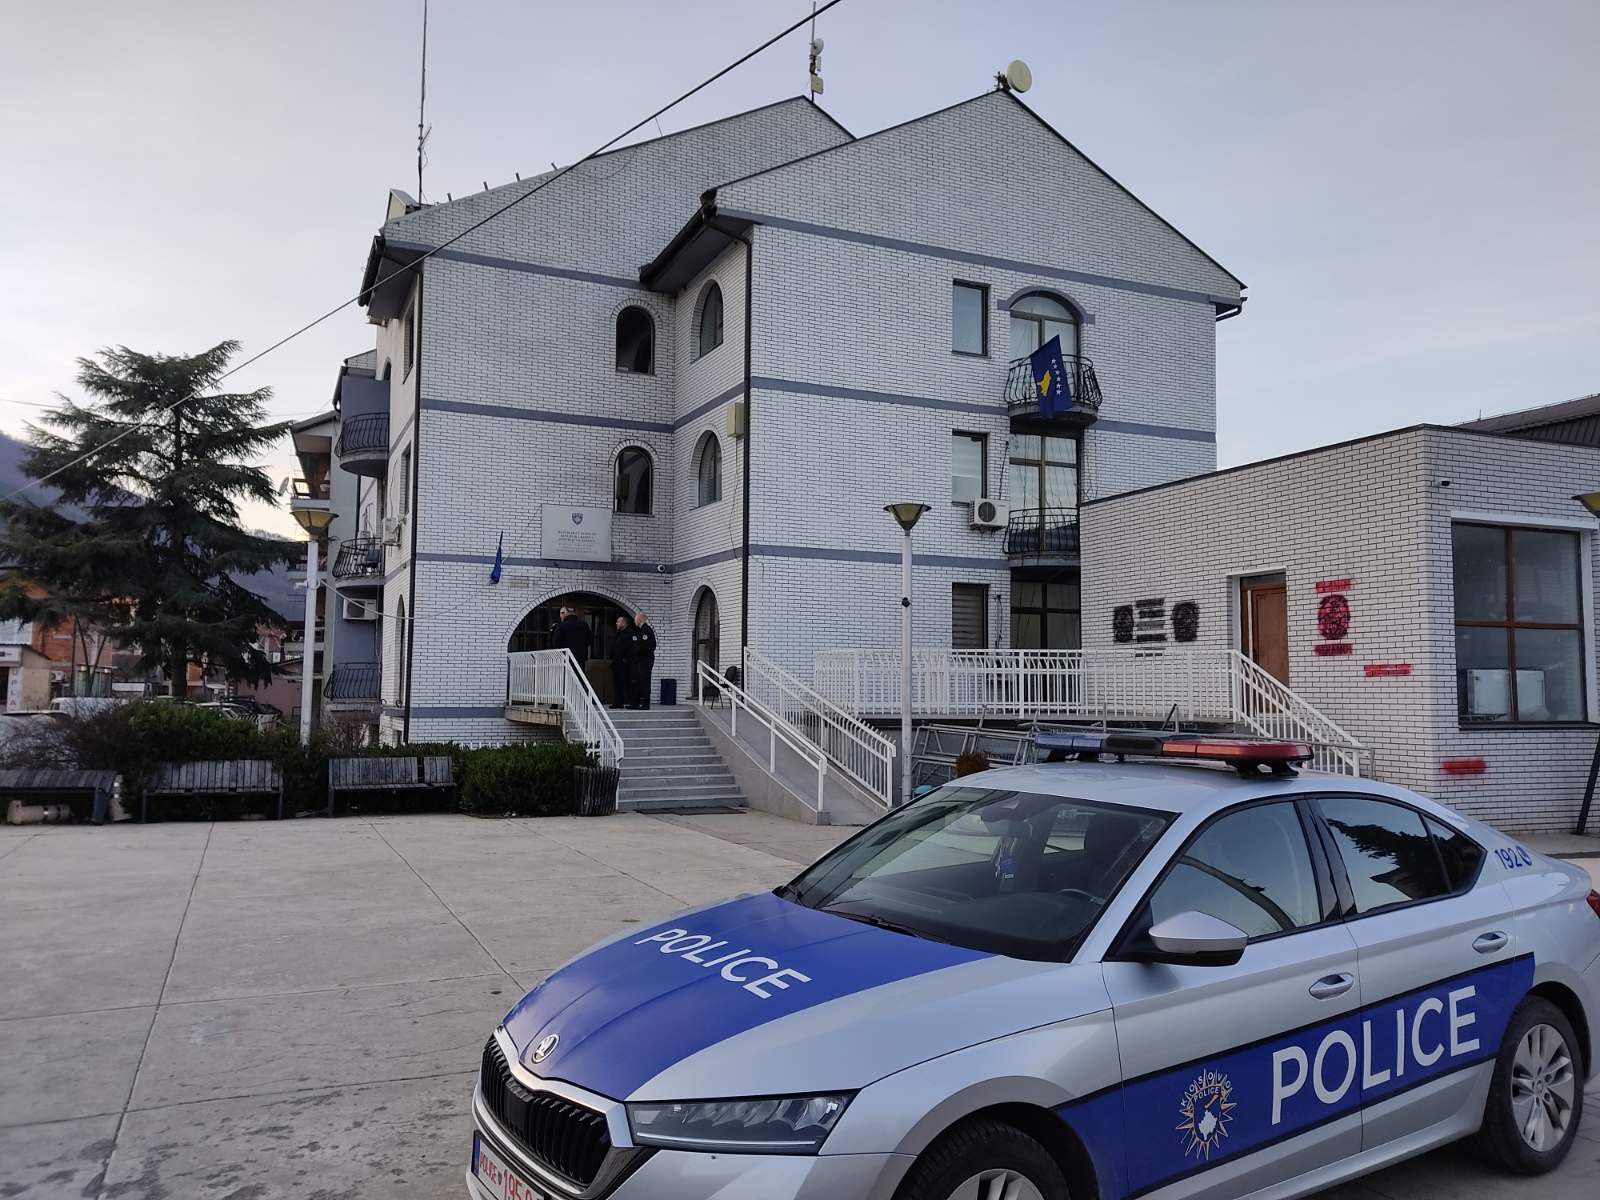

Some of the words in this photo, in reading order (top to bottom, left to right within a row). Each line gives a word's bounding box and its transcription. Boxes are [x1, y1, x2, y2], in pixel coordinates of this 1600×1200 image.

[634, 928, 812, 999] POLICE
[1271, 985, 1480, 1125] POLICE
[1181, 1072, 1231, 1106] KOSOVO
[1194, 1087, 1219, 1102] POLICE
[480, 1152, 497, 1184] POLICE
